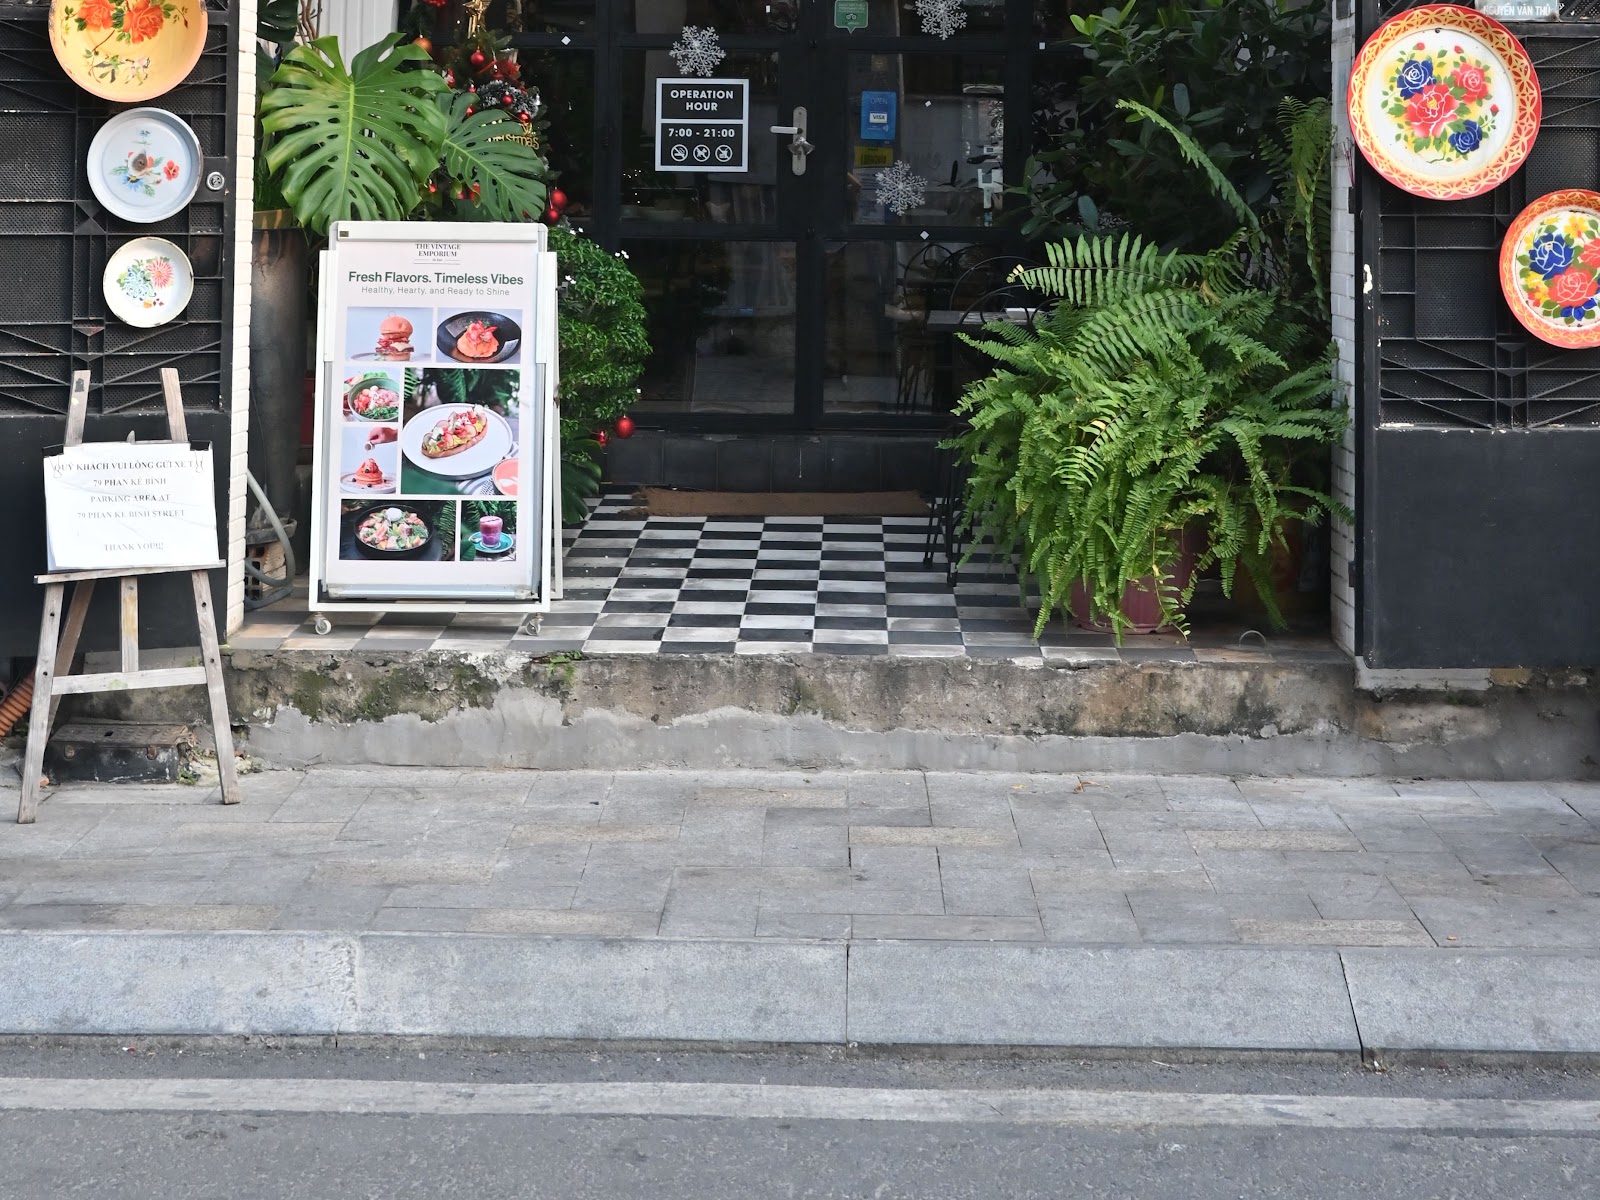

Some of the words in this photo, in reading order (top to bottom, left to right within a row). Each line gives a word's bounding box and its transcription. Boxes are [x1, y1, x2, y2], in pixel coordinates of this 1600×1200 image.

[670, 90, 734, 100] OPERATION
[685, 101, 718, 111] HOUR
[869, 97, 888, 105] OPEN
[668, 128, 692, 138] 7:00
[703, 128, 735, 138] 21:00
[348, 271, 382, 282] Fresh
[385, 271, 432, 283] Flavors.
[434, 272, 488, 284] Timeless
[490, 273, 524, 285] Vibes
[361, 286, 395, 295] Healthy,
[397, 286, 427, 295] Hearty,
[429, 287, 445, 295] and
[447, 287, 473, 297] Ready
[486, 287, 510, 296] Shine
[111, 462, 127, 470] VUI
[104, 478, 128, 486] PHAN
[90, 495, 131, 503] PARKING
[134, 494, 157, 502] AREA
[159, 493, 171, 501] AT
[104, 543, 135, 552] THANK
